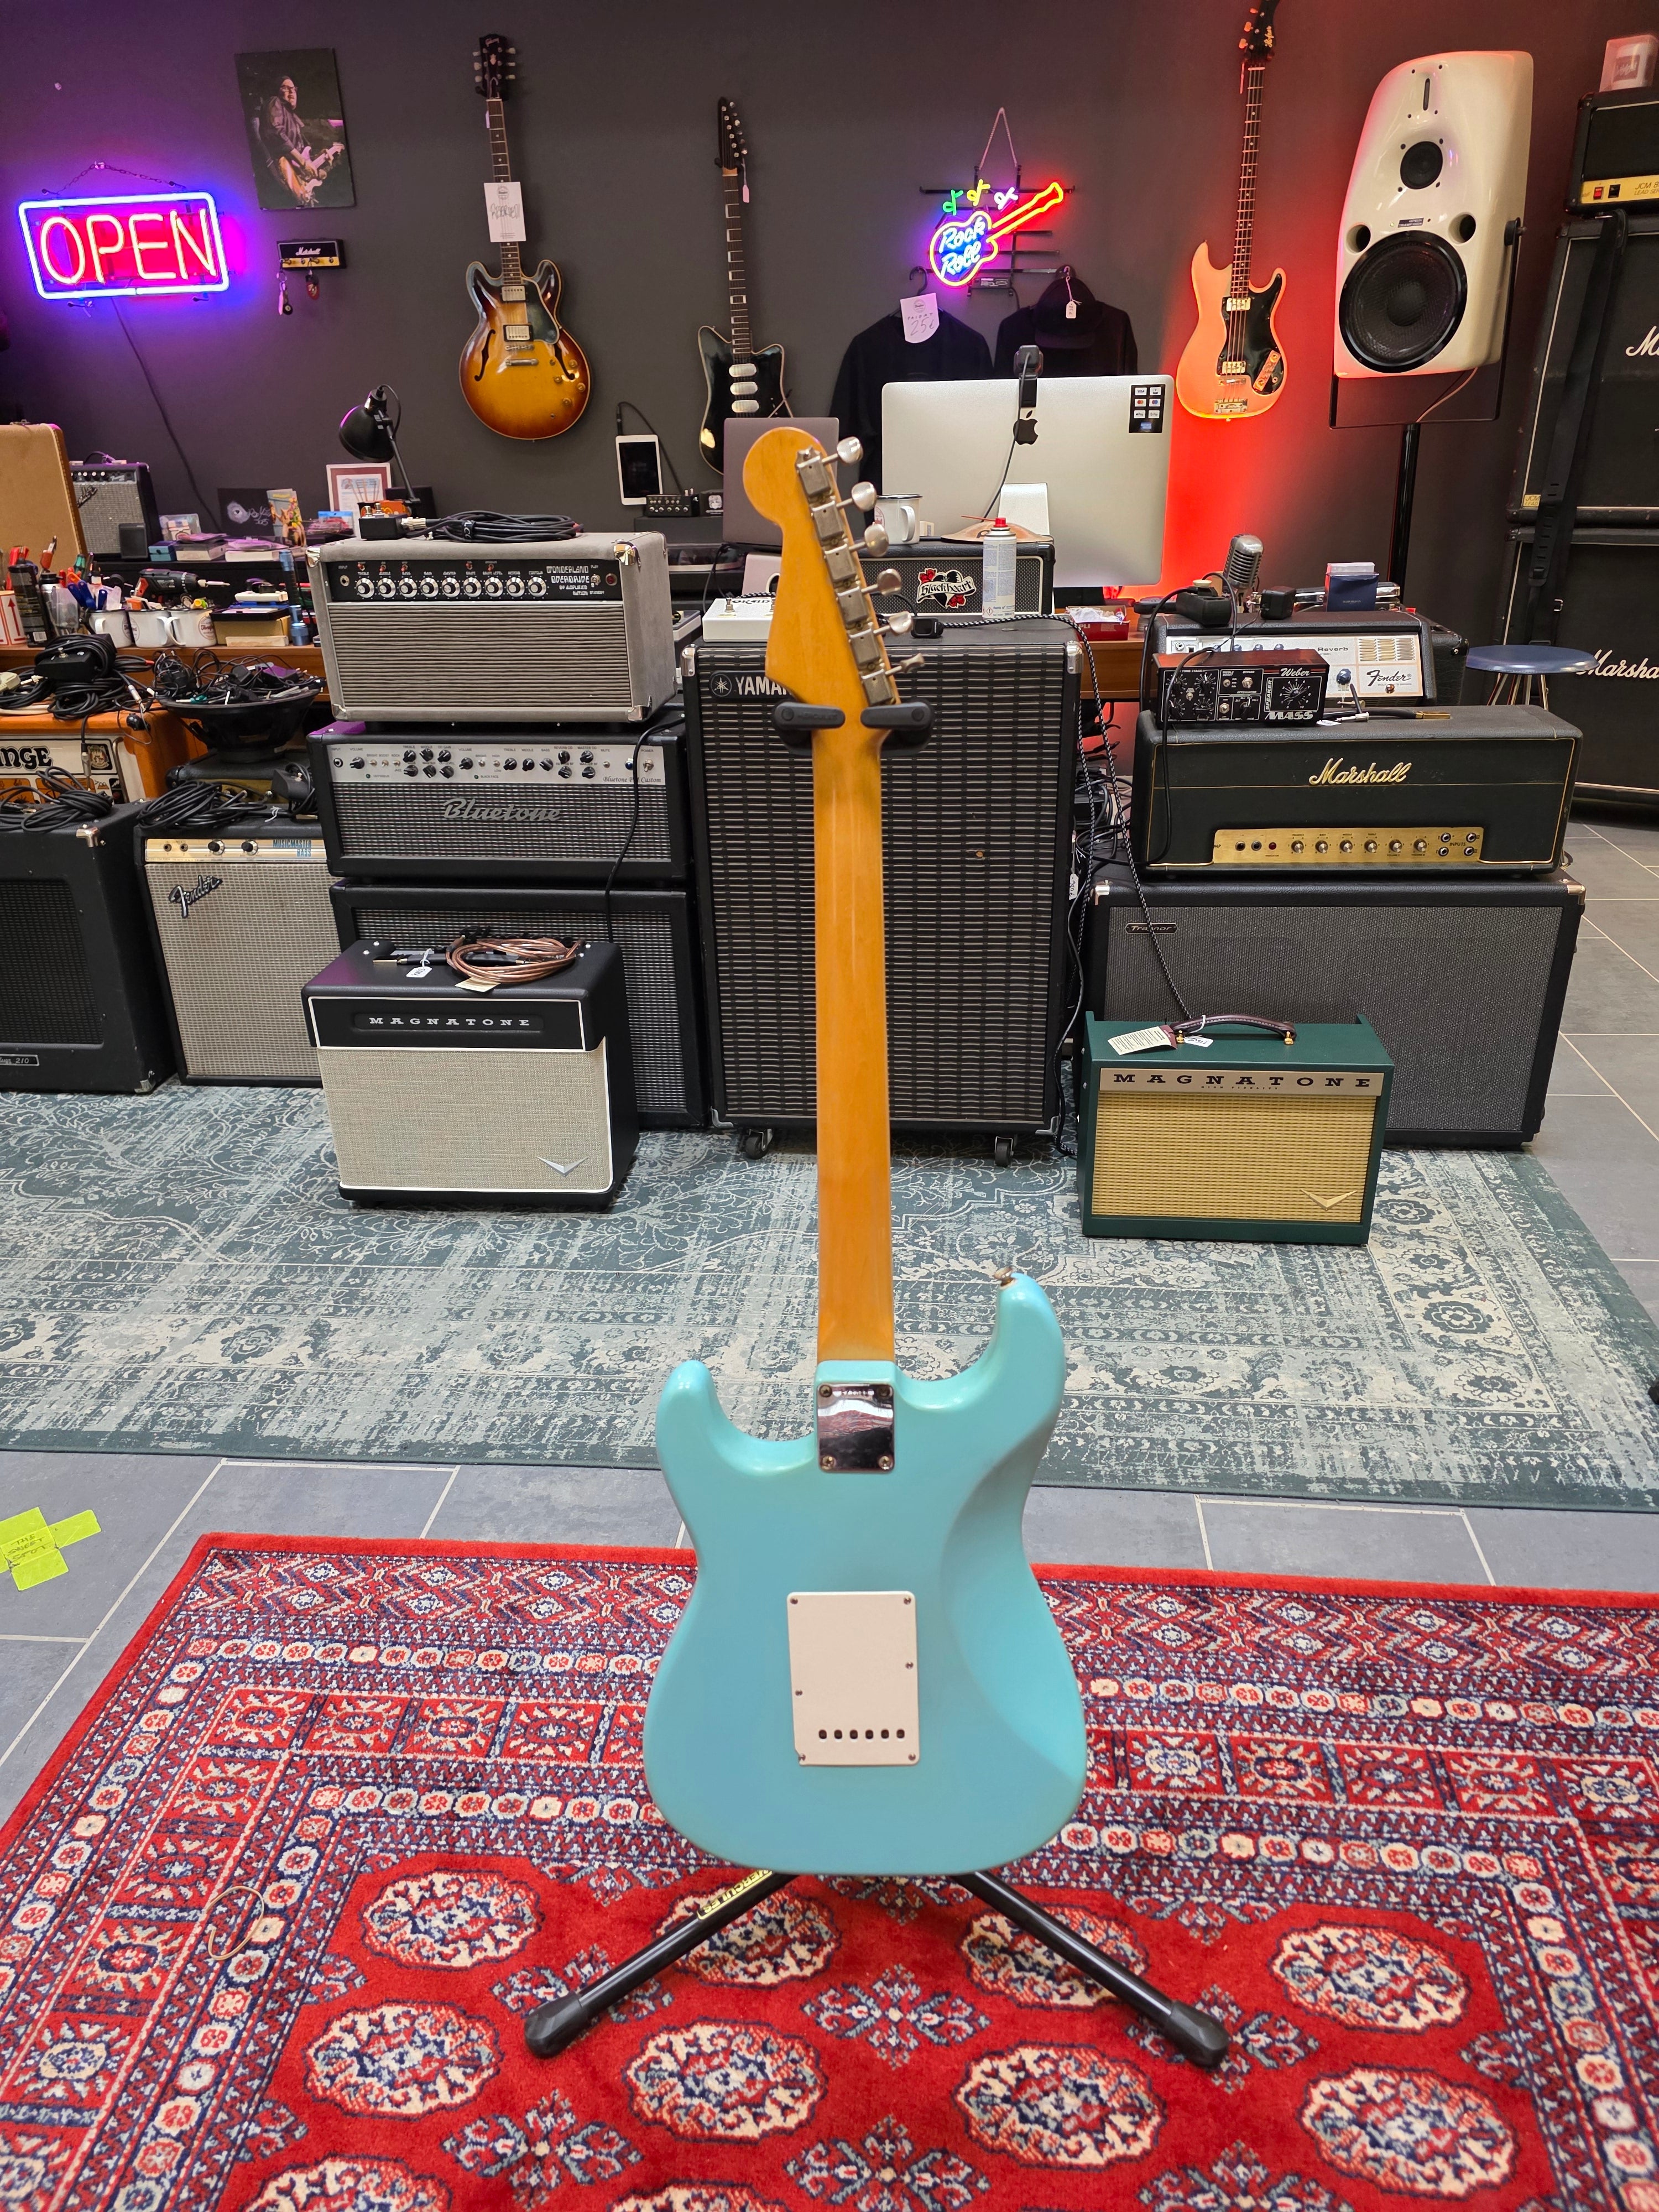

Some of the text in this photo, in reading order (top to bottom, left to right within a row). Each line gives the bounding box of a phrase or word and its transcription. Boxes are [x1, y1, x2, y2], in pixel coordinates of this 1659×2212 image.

[938, 216, 985, 254] Rock
[40, 208, 217, 284] OPEN
[941, 241, 982, 278] Roll
[1625, 325, 1659, 356] M
[551, 575, 590, 583] OVERDRIVE
[920, 579, 972, 596] Blackheart
[1280, 667, 1310, 676] Weber
[1366, 669, 1410, 686] Fender
[735, 676, 792, 695] YAMA
[1264, 711, 1313, 720] MASS
[0, 747, 53, 770] NGE
[1308, 758, 1412, 785] Marshall
[442, 798, 560, 821] Bluetone
[273, 839, 312, 849] MUSICMASTER
[297, 849, 312, 857] BASS
[169, 875, 223, 919] Fender
[369, 1016, 531, 1026] MAGNATONE
[1113, 1073, 1370, 1088] MAGNATONE
[703, 1870, 771, 1914] HERCULES
